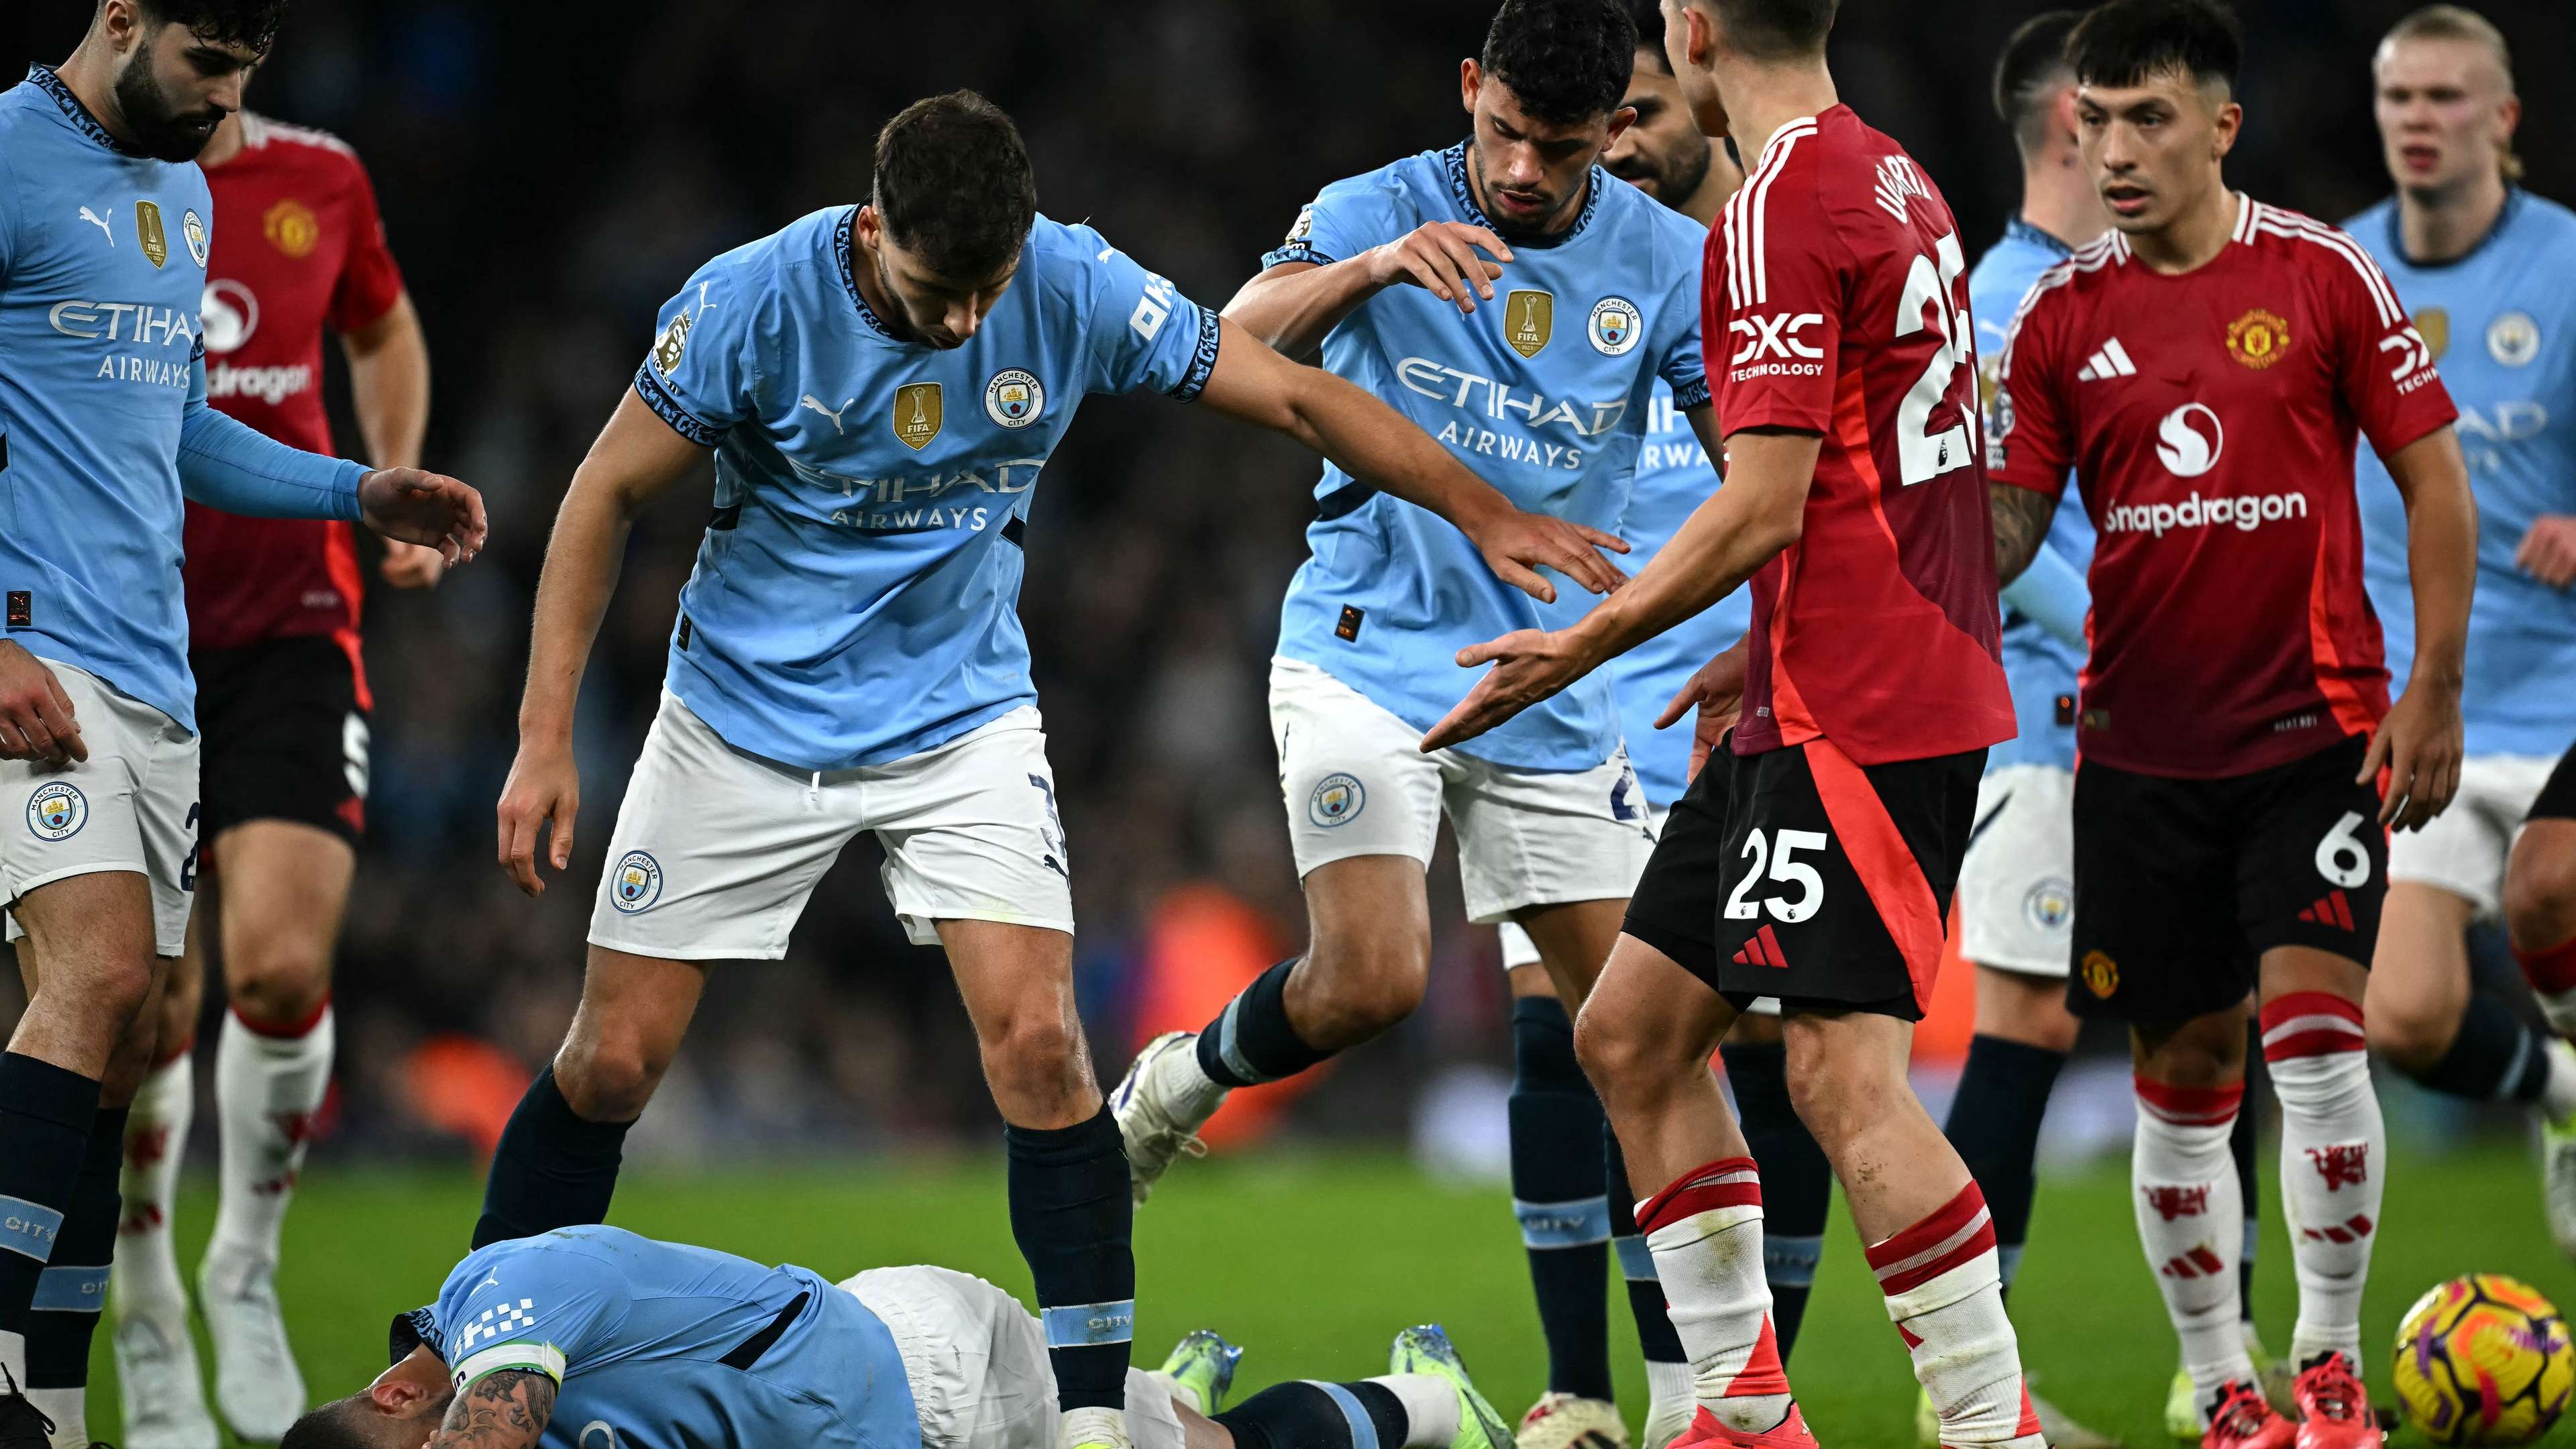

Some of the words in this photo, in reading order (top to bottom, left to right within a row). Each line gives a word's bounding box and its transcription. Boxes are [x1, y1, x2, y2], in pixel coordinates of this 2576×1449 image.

[148, 244, 161, 252] FIFA
[49, 299, 201, 346] ETIHA
[1593, 300, 1638, 321] MANCHESTER
[1517, 332, 1538, 342] FIFA
[1729, 313, 1824, 366] DXC
[2379, 326, 2430, 382] DX
[97, 355, 191, 389] AIRWAYS
[989, 372, 1038, 394] MANCHESTER
[1731, 363, 1824, 383] TECHNOLOGY
[1397, 357, 1628, 435] ETIHAD
[907, 424, 930, 433] FIFA
[1438, 420, 1582, 470] AIRWAYS
[786, 455, 1046, 503] ETIHAD
[830, 507, 988, 531] AIRWAYS
[2105, 490, 2308, 539] Snapdragon
[31, 786, 79, 811] MANCHESTER
[1329, 815, 1346, 824] CITY
[52, 828, 70, 838] CITY
[2315, 810, 2371, 889] 6
[619, 855, 657, 880] MANCHESTER
[1723, 827, 1827, 924] 25
[619, 901, 635, 910] CITY
[5, 1216, 56, 1244] CITY
[1088, 1314, 1132, 1330] CITY
